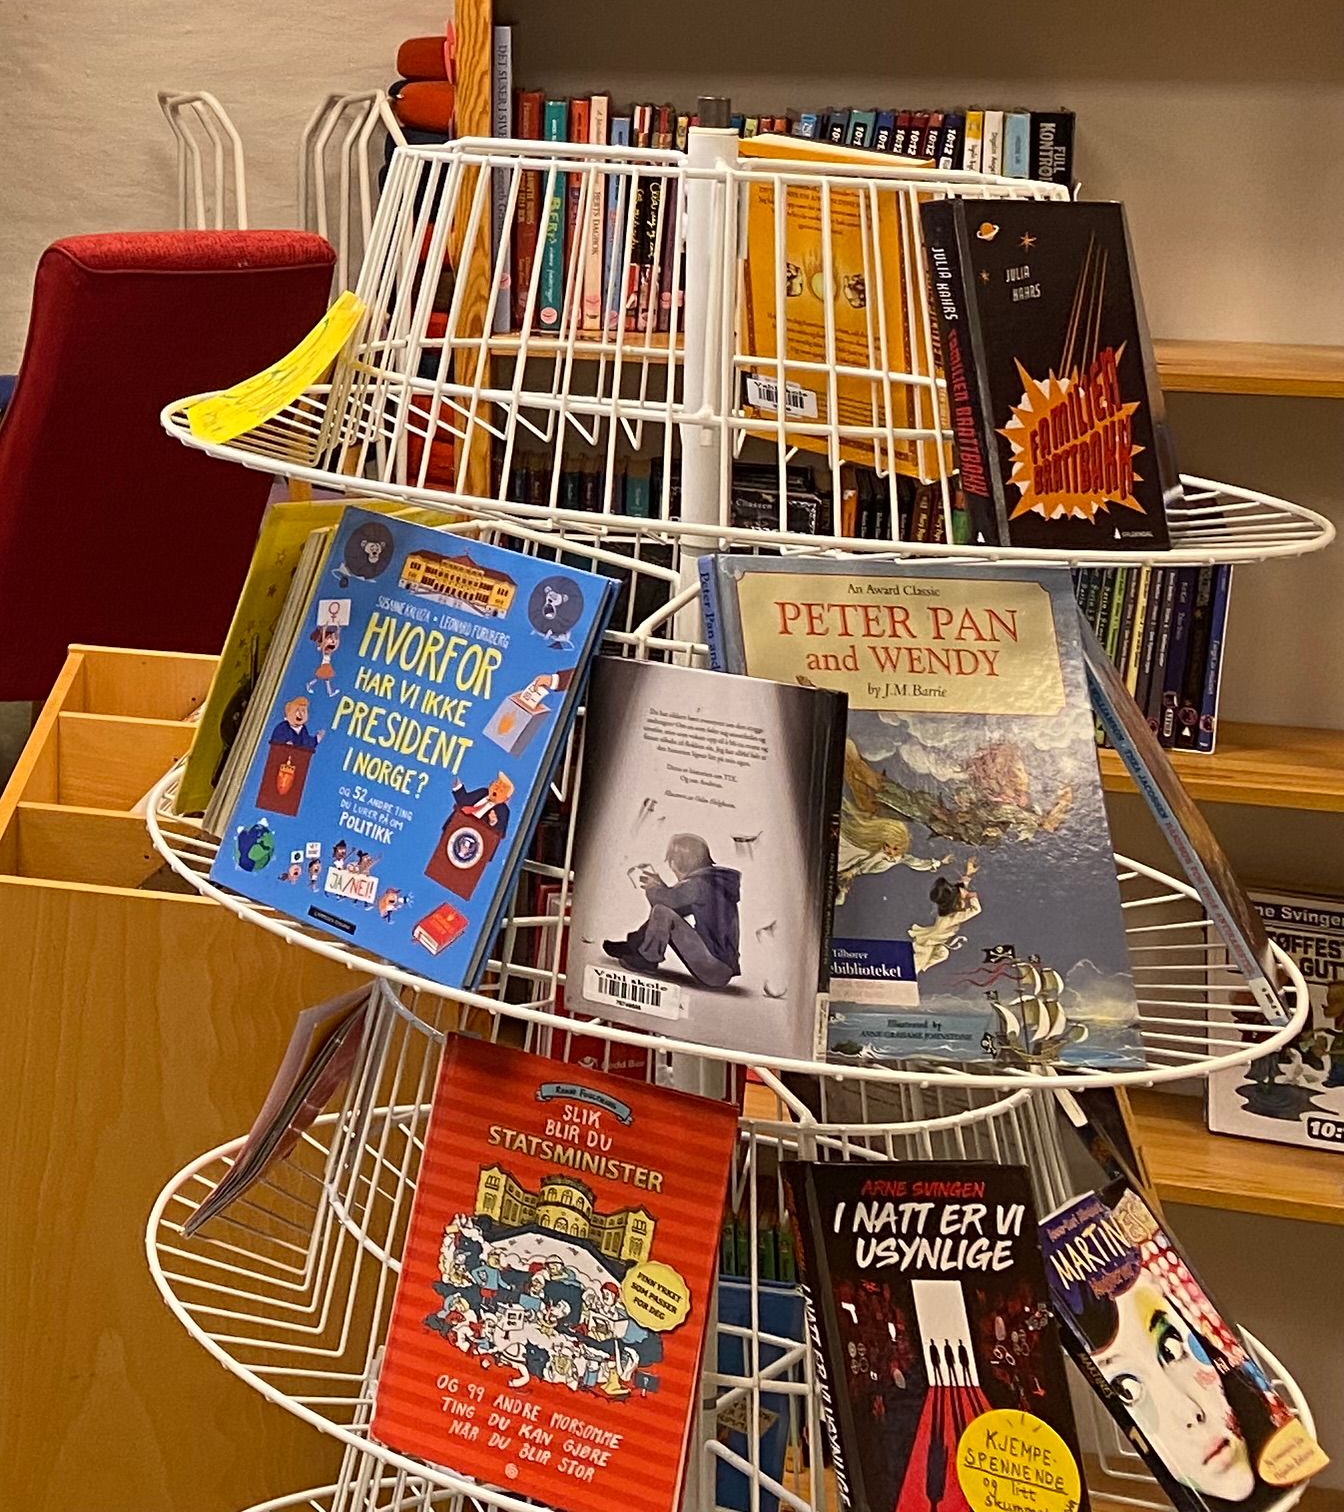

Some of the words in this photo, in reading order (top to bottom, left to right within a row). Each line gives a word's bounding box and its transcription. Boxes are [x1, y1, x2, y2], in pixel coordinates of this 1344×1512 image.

[497, 45, 508, 69] DET
[497, 72, 508, 104] SUSER
[498, 113, 508, 139] SIVE
[944, 129, 957, 155] 10:12
[907, 130, 920, 155] 10:12
[926, 130, 938, 156] 10:12
[1054, 146, 1066, 173] FULL
[931, 247, 952, 280] JULIA
[1006, 265, 1030, 283] JULIA
[935, 282, 959, 321] KAHRS
[1030, 346, 1122, 465] FAMILIEN
[700, 573, 711, 607] Peter
[847, 583, 863, 594] An
[866, 584, 900, 596] Award
[903, 586, 940, 597] Classic
[705, 613, 715, 639] Pan
[774, 601, 917, 639] PETER
[927, 607, 1018, 642] PAN
[358, 612, 502, 700] HVORFOR
[709, 644, 721, 669] and
[806, 645, 860, 672] and
[868, 645, 1000, 677] WENDY
[354, 666, 395, 700] HAR
[400, 679, 421, 709] VI
[421, 689, 472, 727] IKKE
[868, 682, 881, 696] by
[913, 687, 948, 698] Barrie
[331, 695, 474, 775] PRESIDENT
[342, 747, 354, 771] I
[352, 751, 429, 799] NORGE?
[338, 786, 351, 798] OG
[352, 786, 369, 802] 52
[367, 798, 394, 812] ANDRE
[340, 798, 351, 810] DU
[352, 801, 377, 822] LURER
[378, 812, 389, 825] PÅ
[389, 817, 404, 831] OM
[339, 811, 394, 845] POLITIKK
[594, 968, 626, 982] Vahl
[631, 979, 668, 991] skole
[562, 1104, 602, 1129] SLIK
[546, 1119, 580, 1144] BLIR
[587, 1131, 612, 1152] DU
[488, 1126, 663, 1193] STATSMINISTER
[862, 1180, 907, 1197] ARNE
[911, 1181, 985, 1198] SVINGEN
[833, 1202, 846, 1234] I
[852, 1201, 935, 1235] NATT
[940, 1203, 987, 1236] ER
[996, 1203, 1026, 1236] VI
[856, 1236, 1014, 1272] USYNLIGE
[631, 1282, 648, 1296] SOM
[649, 1293, 677, 1314] PASSER
[634, 1297, 649, 1310] FOR
[649, 1306, 665, 1319] DEG
[436, 1374, 459, 1393] OG
[467, 1383, 485, 1402] 99
[493, 1394, 542, 1422] ANDRE
[550, 1412, 624, 1449] MORSOMME
[441, 1396, 476, 1419] TING
[487, 1413, 511, 1431] DU
[518, 1423, 553, 1446] KAN
[562, 1439, 612, 1467] GJØRE
[448, 1420, 480, 1441] NÅR
[487, 1433, 512, 1450] DU
[519, 1443, 552, 1465] BLIR
[557, 1457, 596, 1483] STOR
[964, 1448, 1064, 1490] SPENNENDE
[983, 1478, 997, 1500] og
[1012, 1480, 1037, 1502] litt
